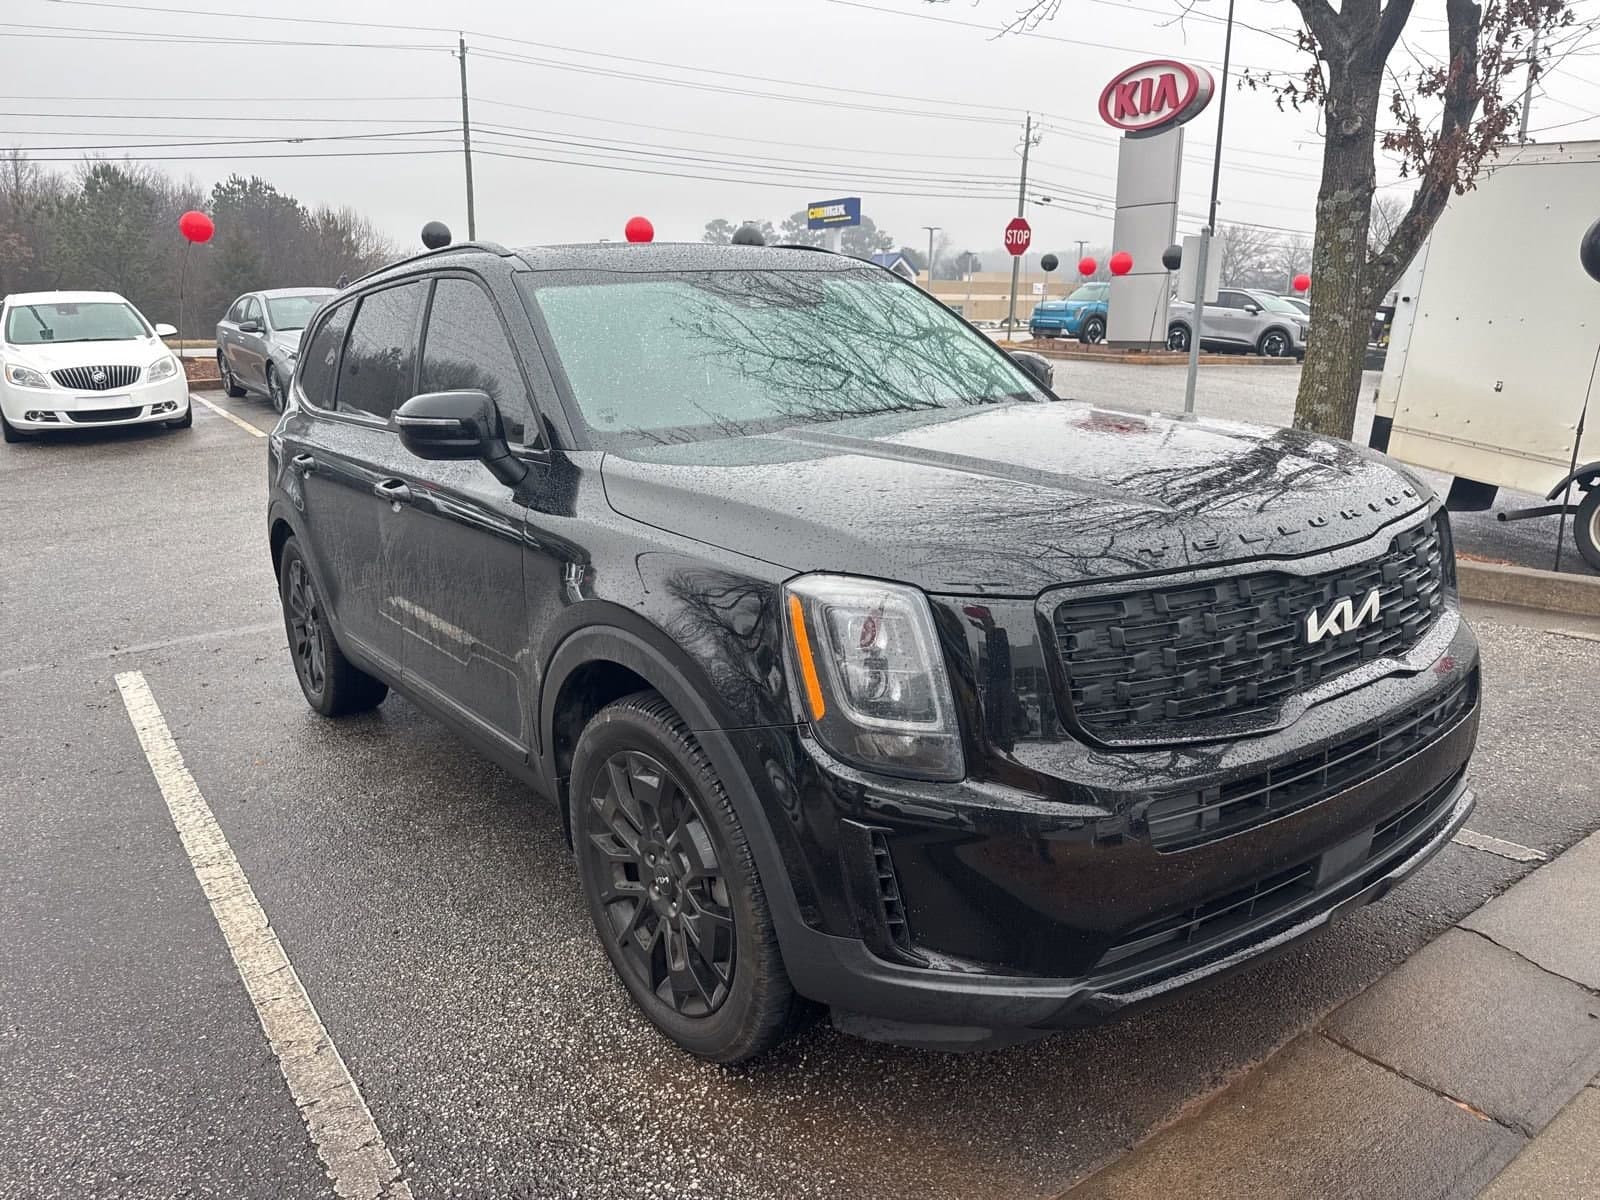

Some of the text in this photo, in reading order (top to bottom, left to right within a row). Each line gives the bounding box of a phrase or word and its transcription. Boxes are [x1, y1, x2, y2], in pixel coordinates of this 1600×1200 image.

[1114, 73, 1180, 119] KIA
[1006, 229, 1030, 245] STOP
[1304, 586, 1381, 644] KIA
